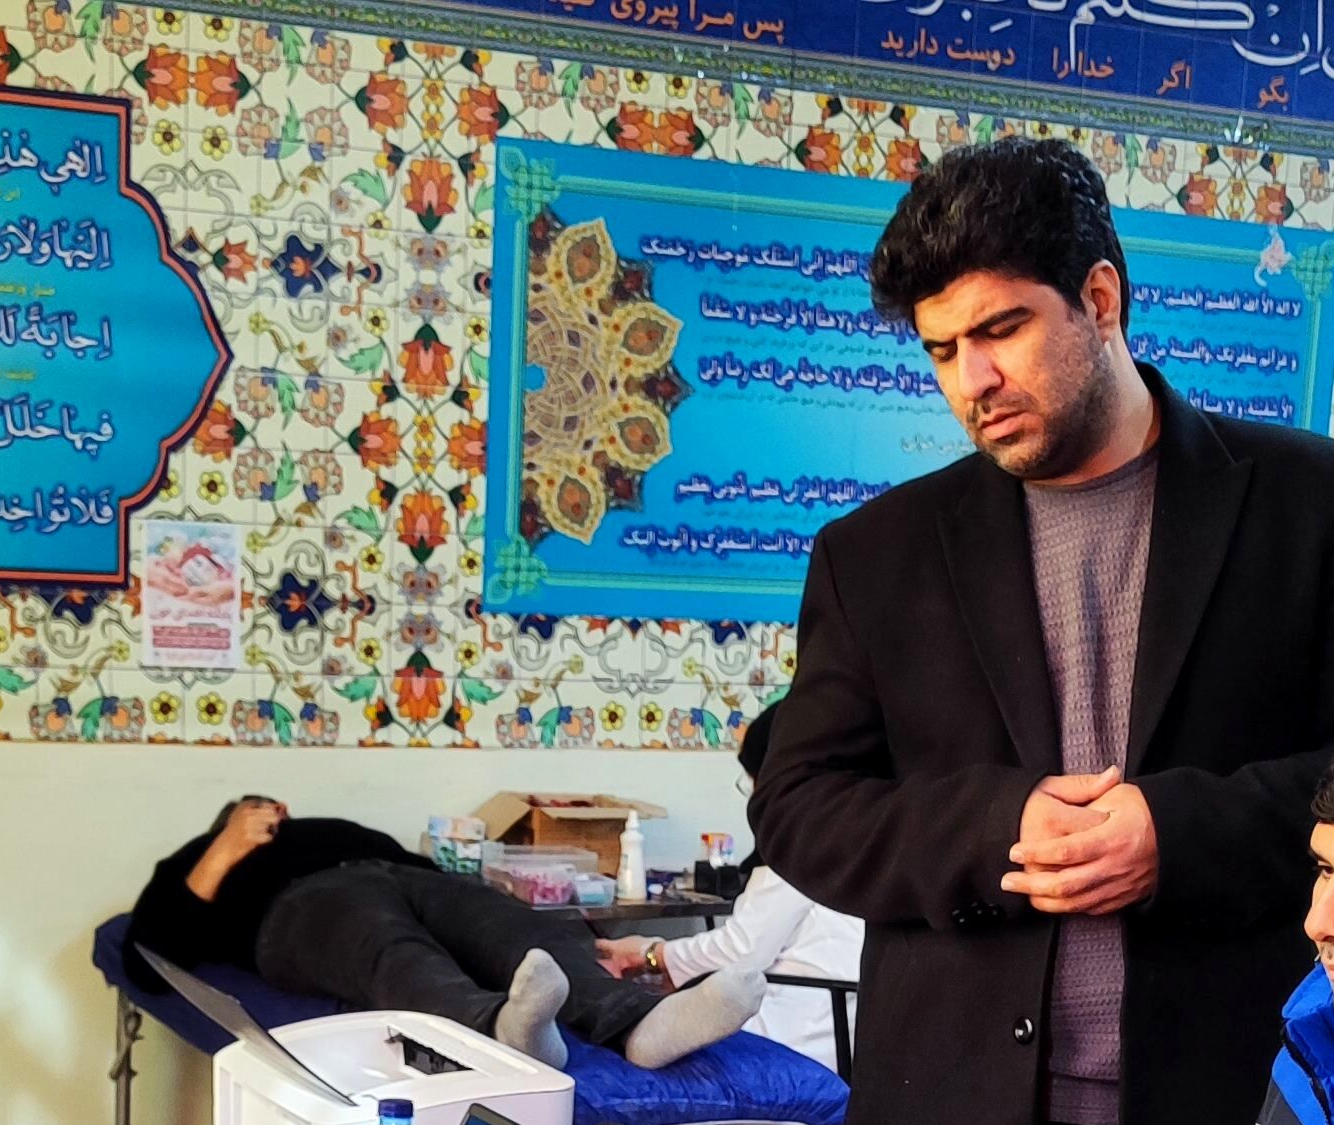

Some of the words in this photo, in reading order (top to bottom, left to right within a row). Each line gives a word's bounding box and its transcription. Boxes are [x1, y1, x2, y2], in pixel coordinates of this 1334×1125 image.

[689, 0, 735, 31] مرا
[742, 18, 784, 45] پس
[881, 28, 938, 59] دارید
[947, 36, 1016, 71] دوست
[1155, 59, 1193, 95] اگر
